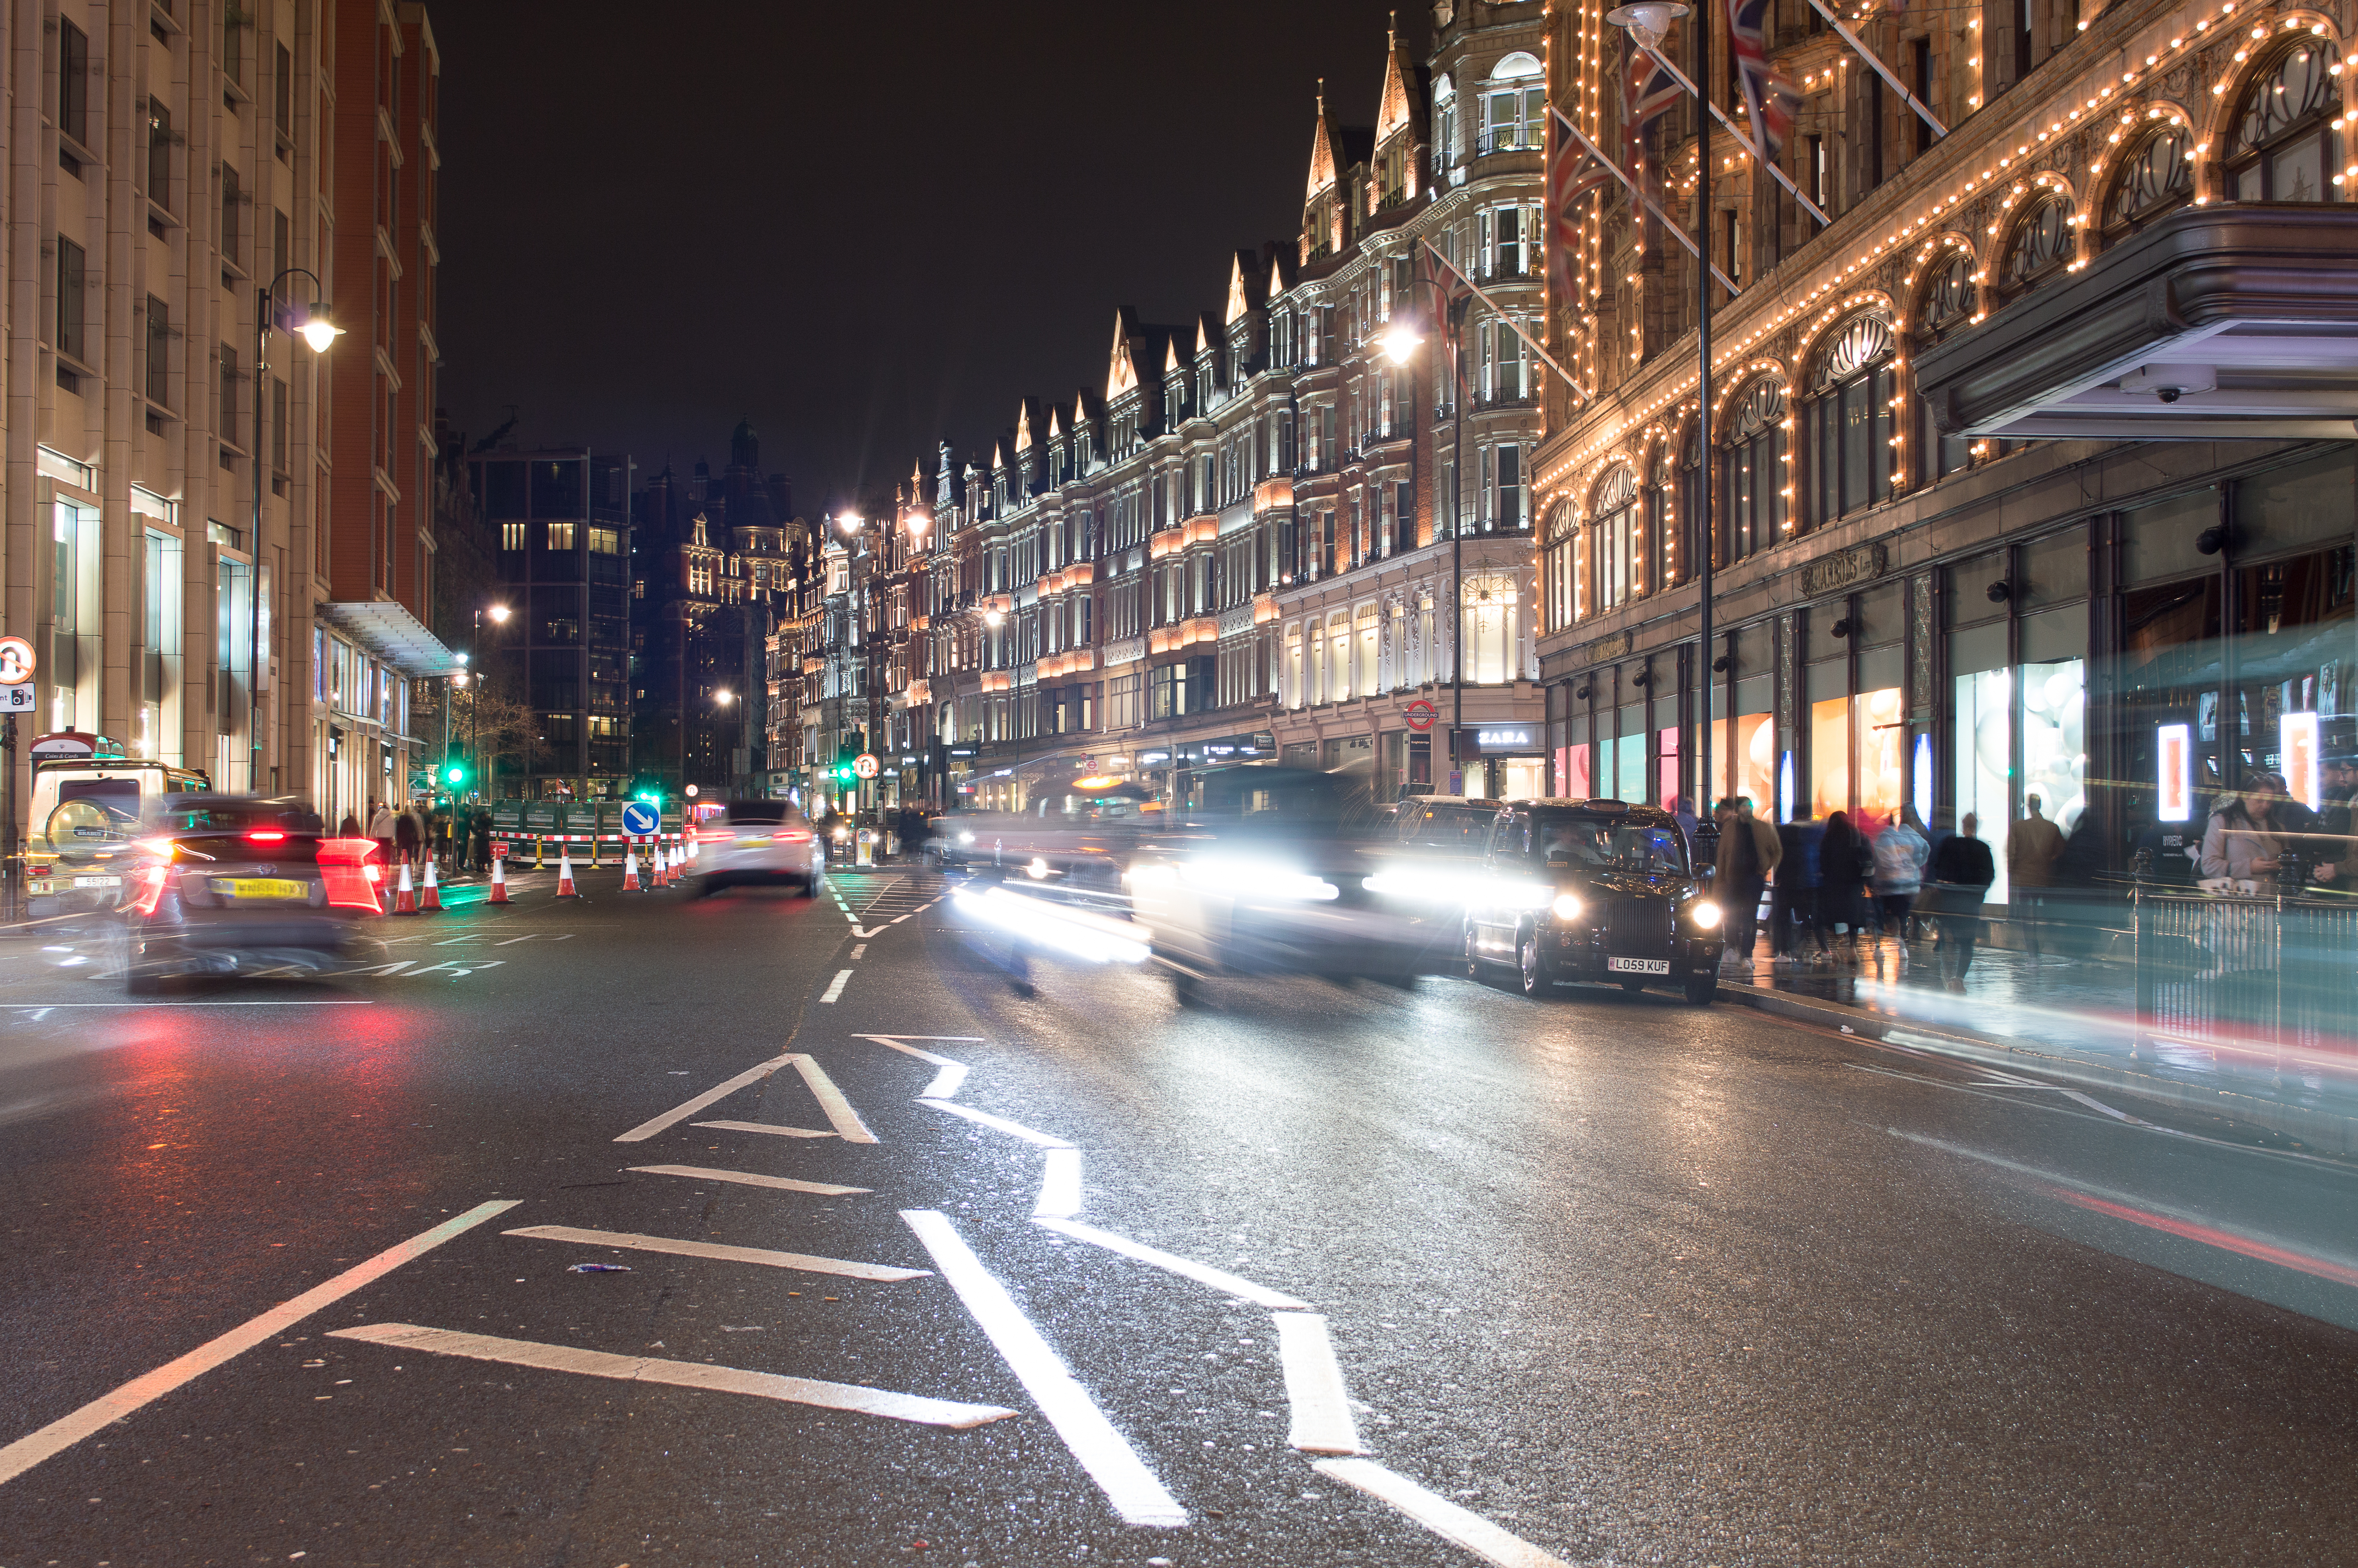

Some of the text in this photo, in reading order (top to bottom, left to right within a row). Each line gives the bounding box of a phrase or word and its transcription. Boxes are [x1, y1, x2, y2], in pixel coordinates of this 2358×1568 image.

[1479, 732, 1528, 744] ZARA
[1616, 959, 1667, 972] LO59 KUF
